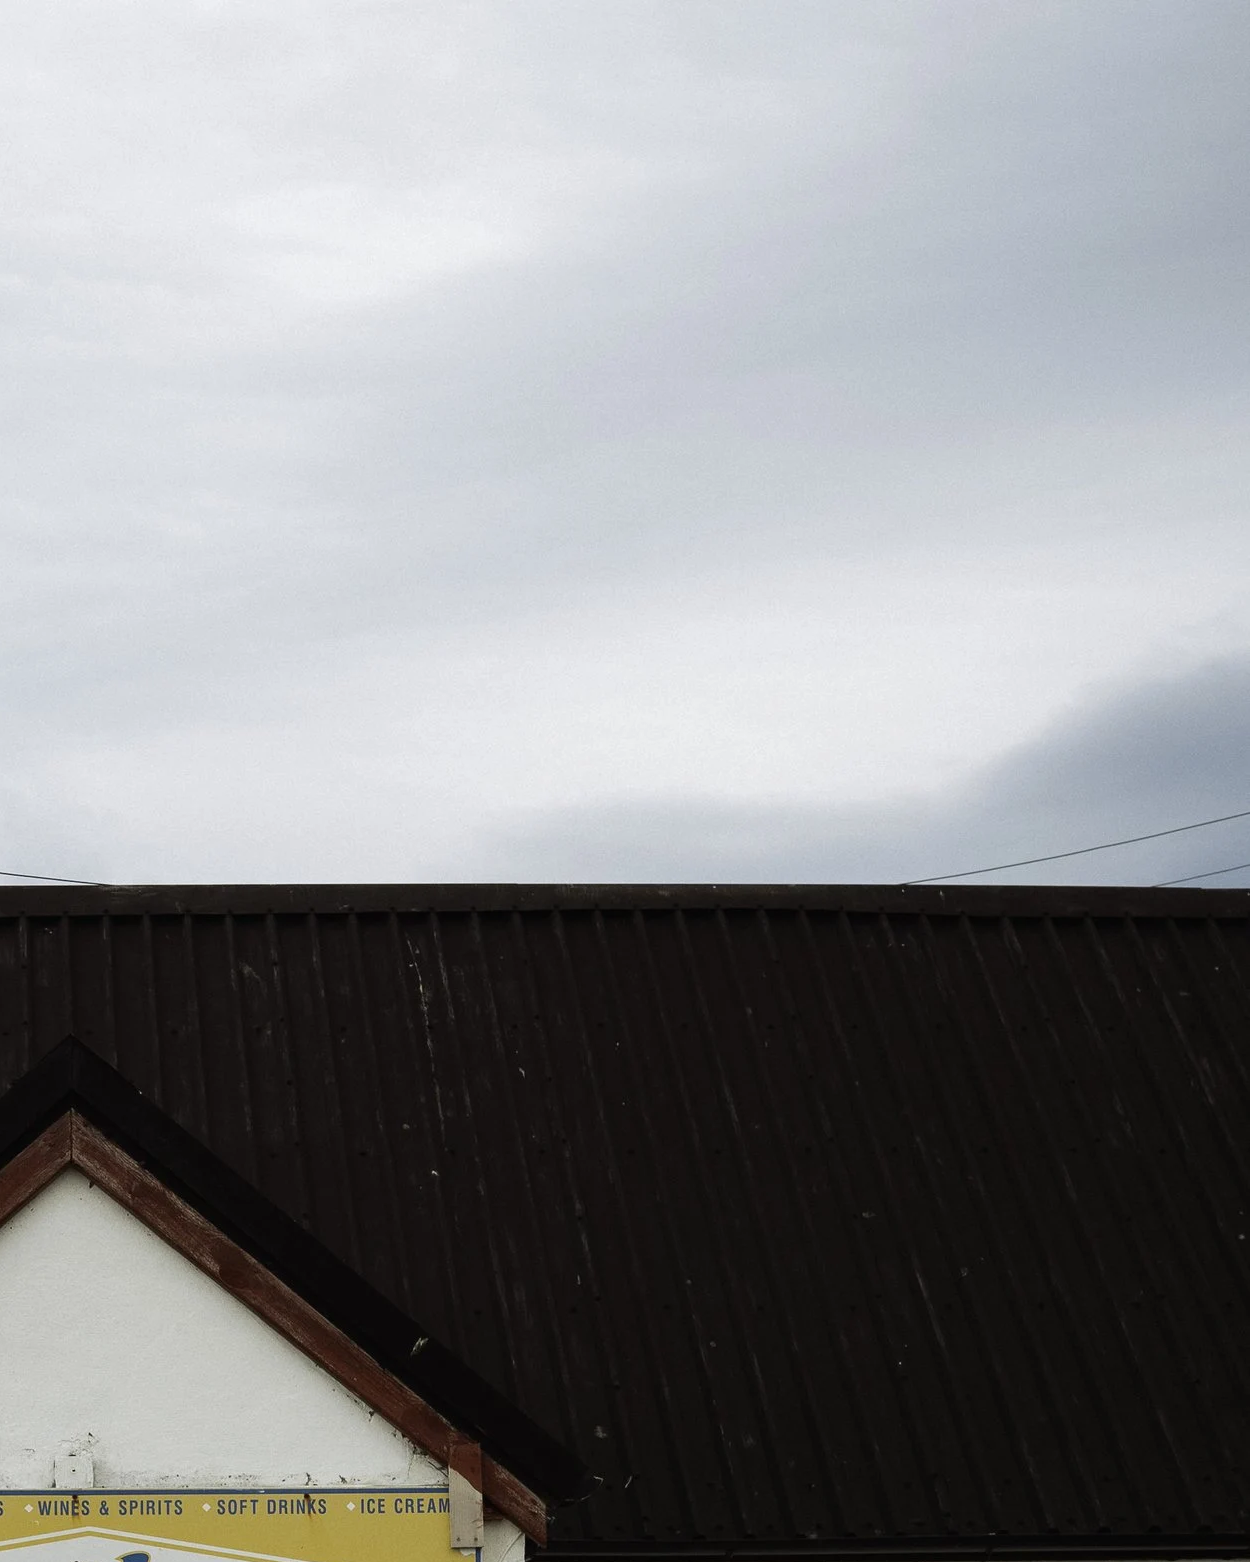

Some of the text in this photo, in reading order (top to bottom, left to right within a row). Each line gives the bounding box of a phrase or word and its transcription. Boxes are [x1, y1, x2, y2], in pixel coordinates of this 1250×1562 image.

[38, 1500, 184, 1516] WINES & SPIRITS
[217, 1499, 328, 1515] SOFT DRINKS
[360, 1498, 450, 1514] ICE CREAM
